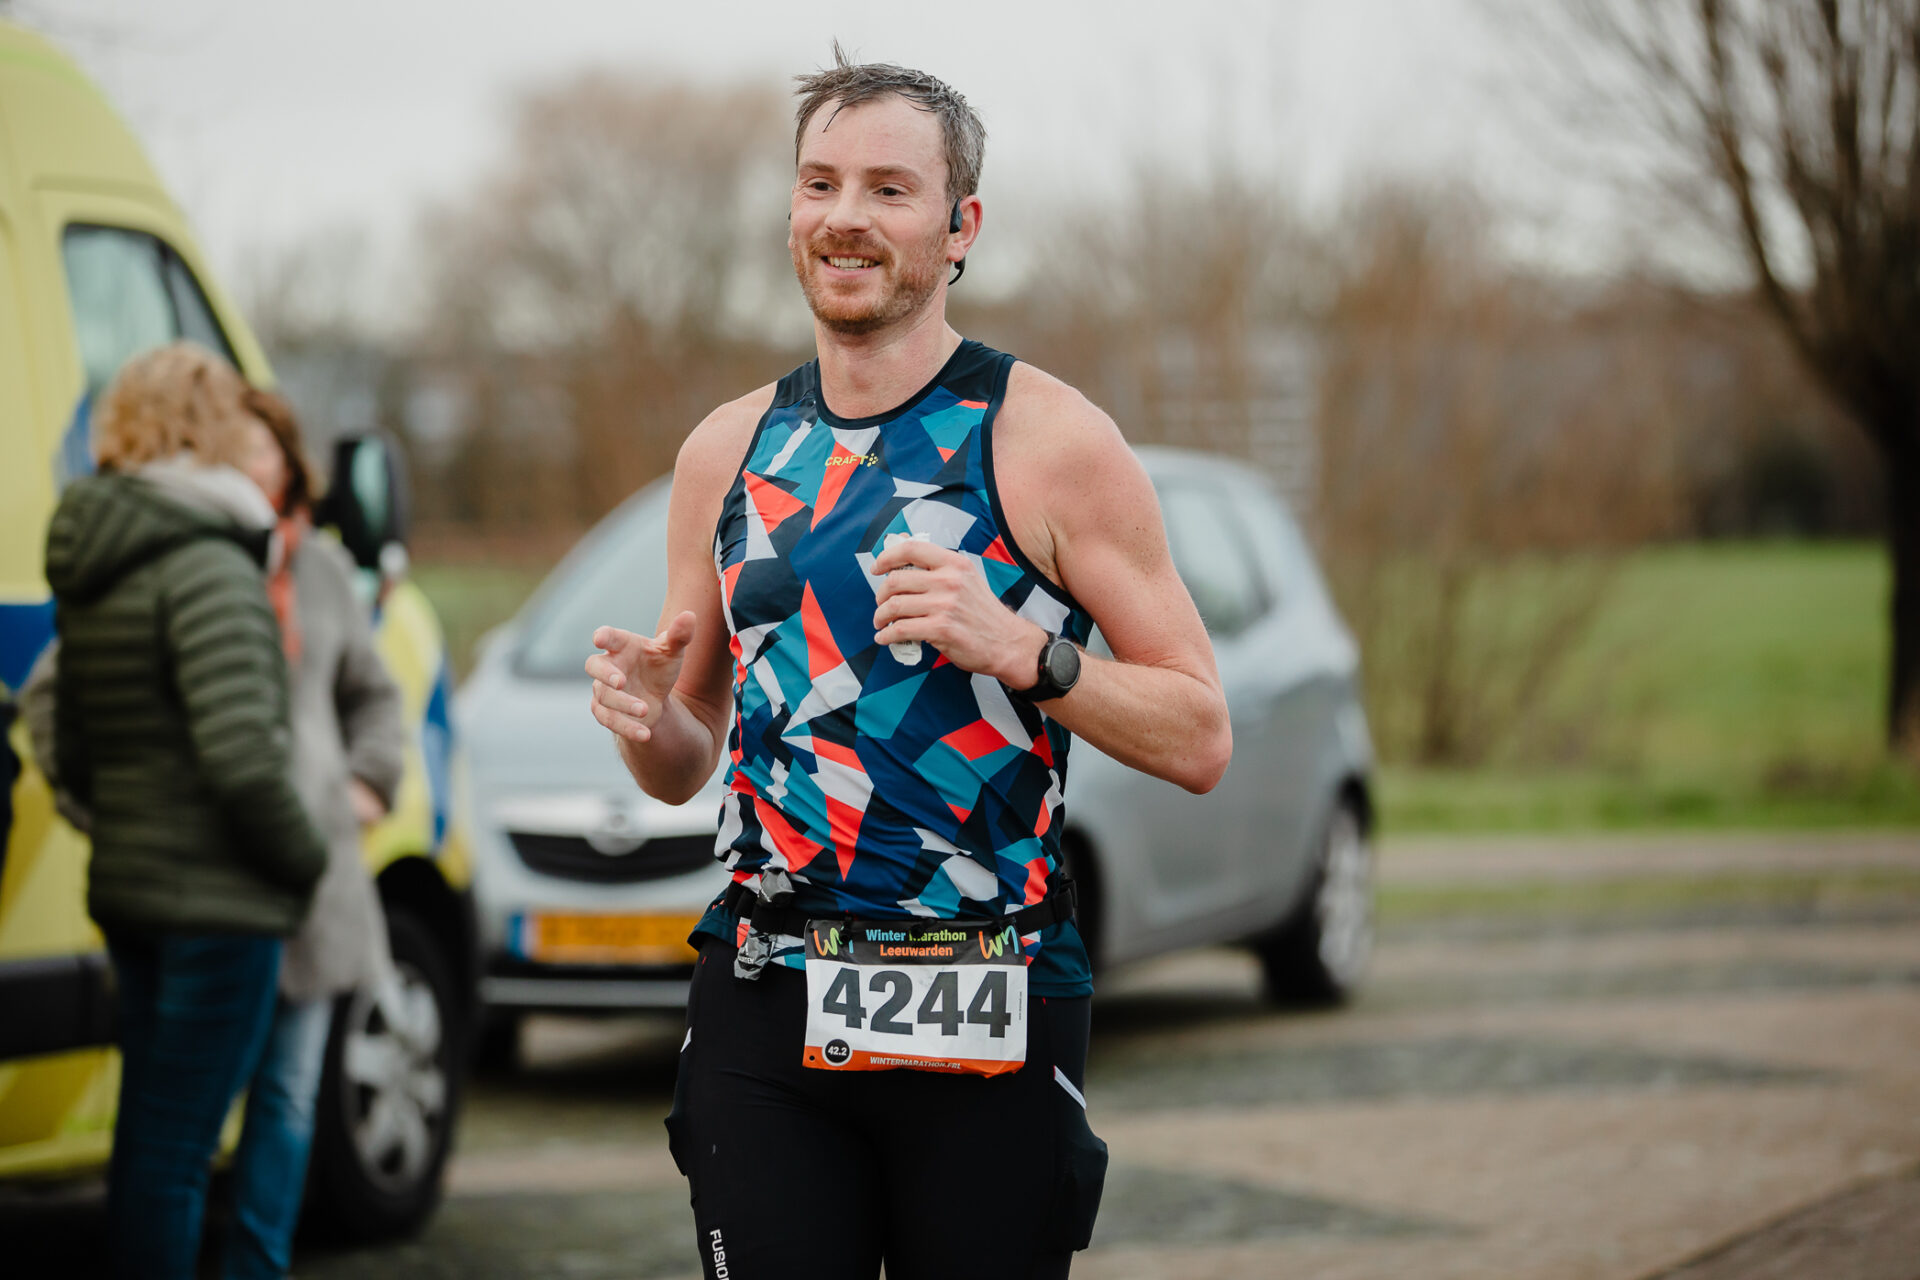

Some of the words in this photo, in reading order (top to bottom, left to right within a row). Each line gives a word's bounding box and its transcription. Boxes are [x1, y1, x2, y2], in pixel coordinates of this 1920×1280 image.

[825, 455, 868, 466] CRAFT
[865, 929, 906, 941] Winter
[880, 944, 953, 956] Leeuwarden
[822, 967, 1012, 1038] 4244
[828, 1046, 847, 1056] 42.2
[870, 1056, 961, 1069] WINTERMARATHON.FRL
[710, 1229, 729, 1280] FUSIO
